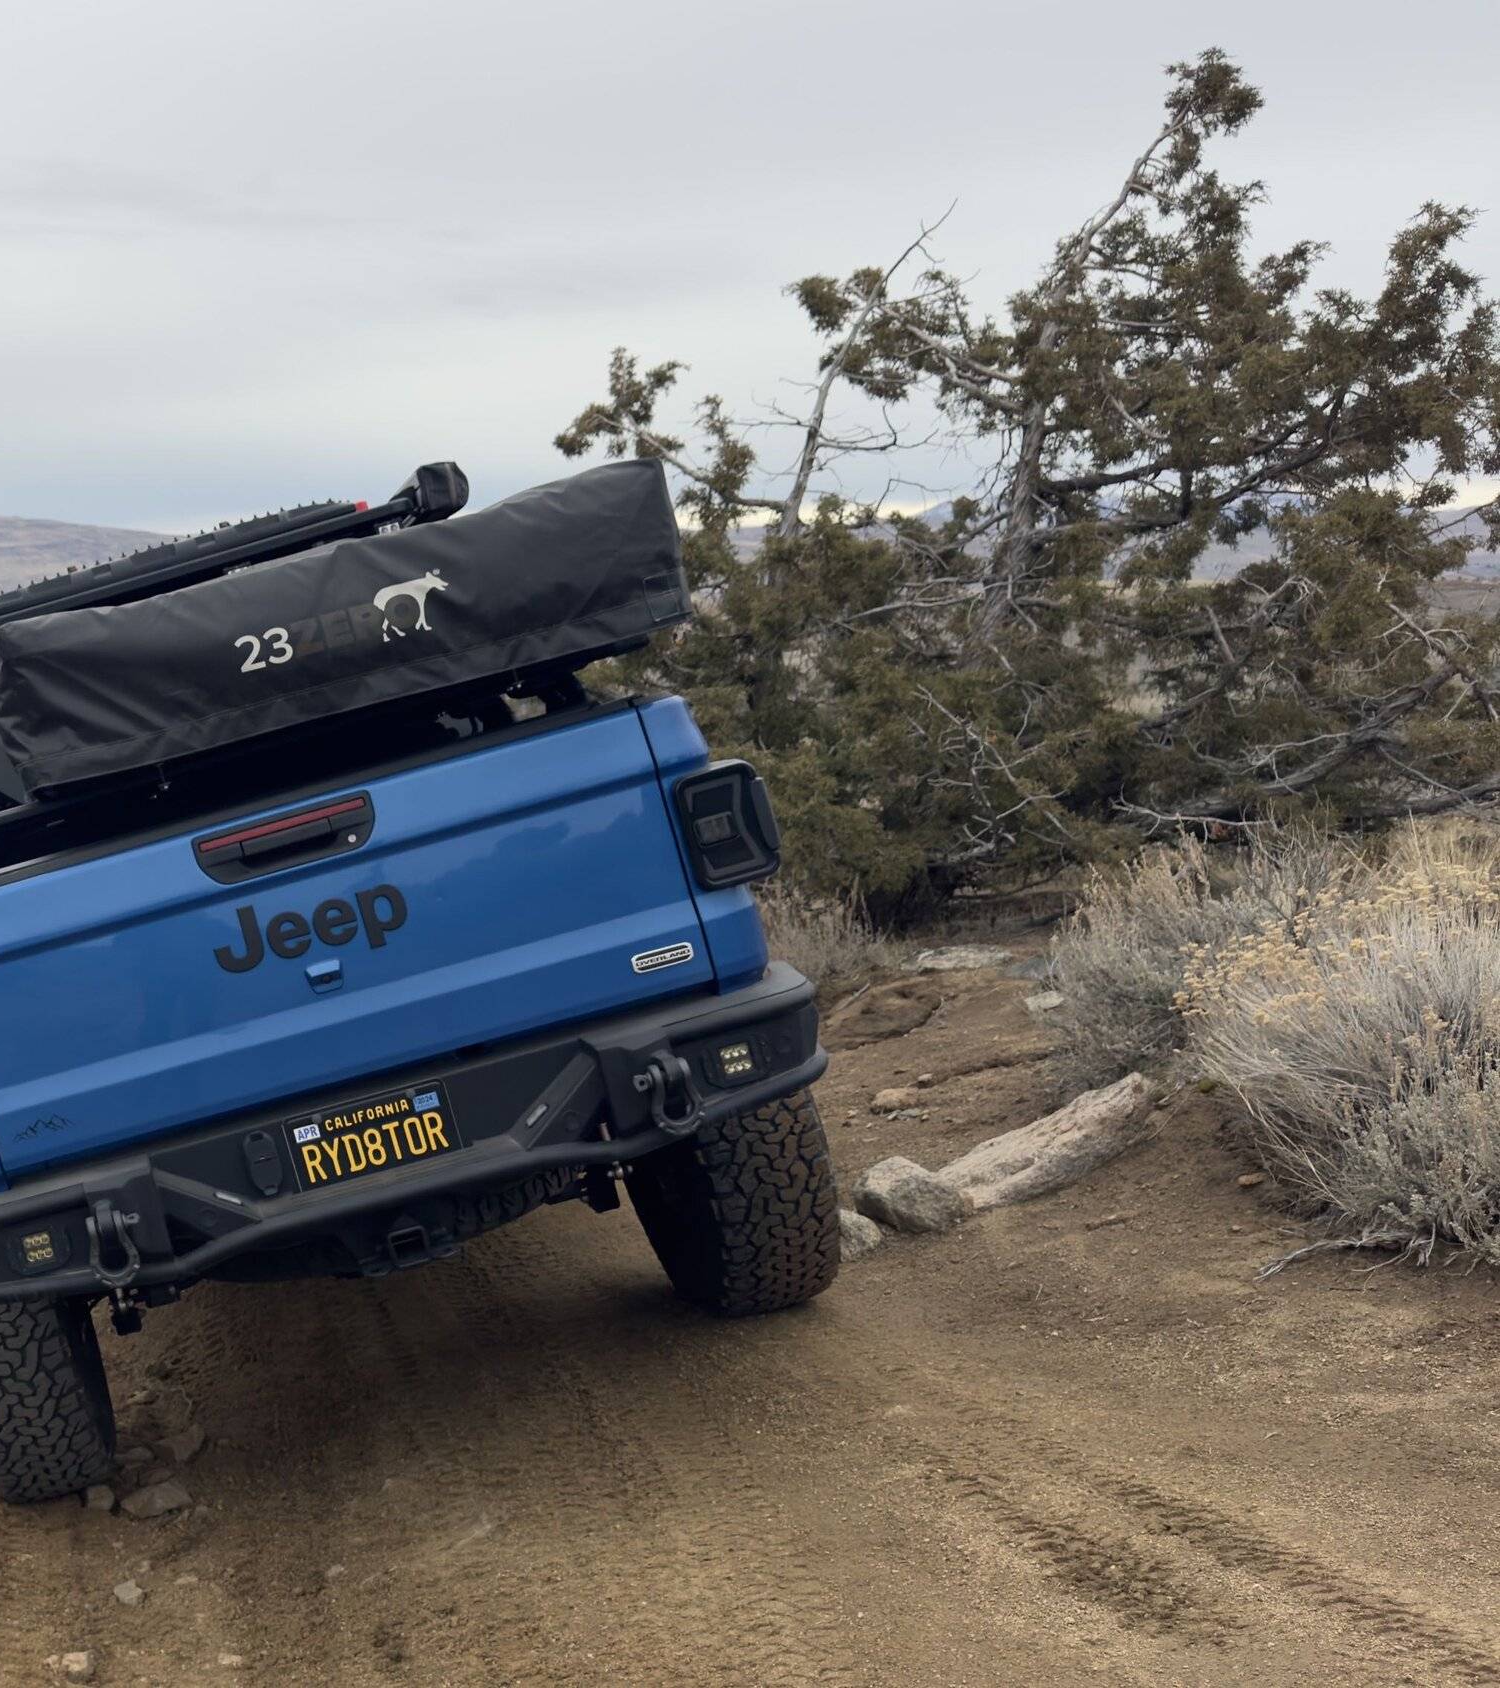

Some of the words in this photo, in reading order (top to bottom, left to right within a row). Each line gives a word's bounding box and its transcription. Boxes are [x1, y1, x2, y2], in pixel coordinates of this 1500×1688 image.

[213, 884, 408, 974] Jeep
[635, 949, 692, 967] OVERLAND
[324, 1099, 409, 1132] CALIFORNIA
[297, 1126, 319, 1141] APR
[301, 1111, 450, 1184] RYD8TOR
